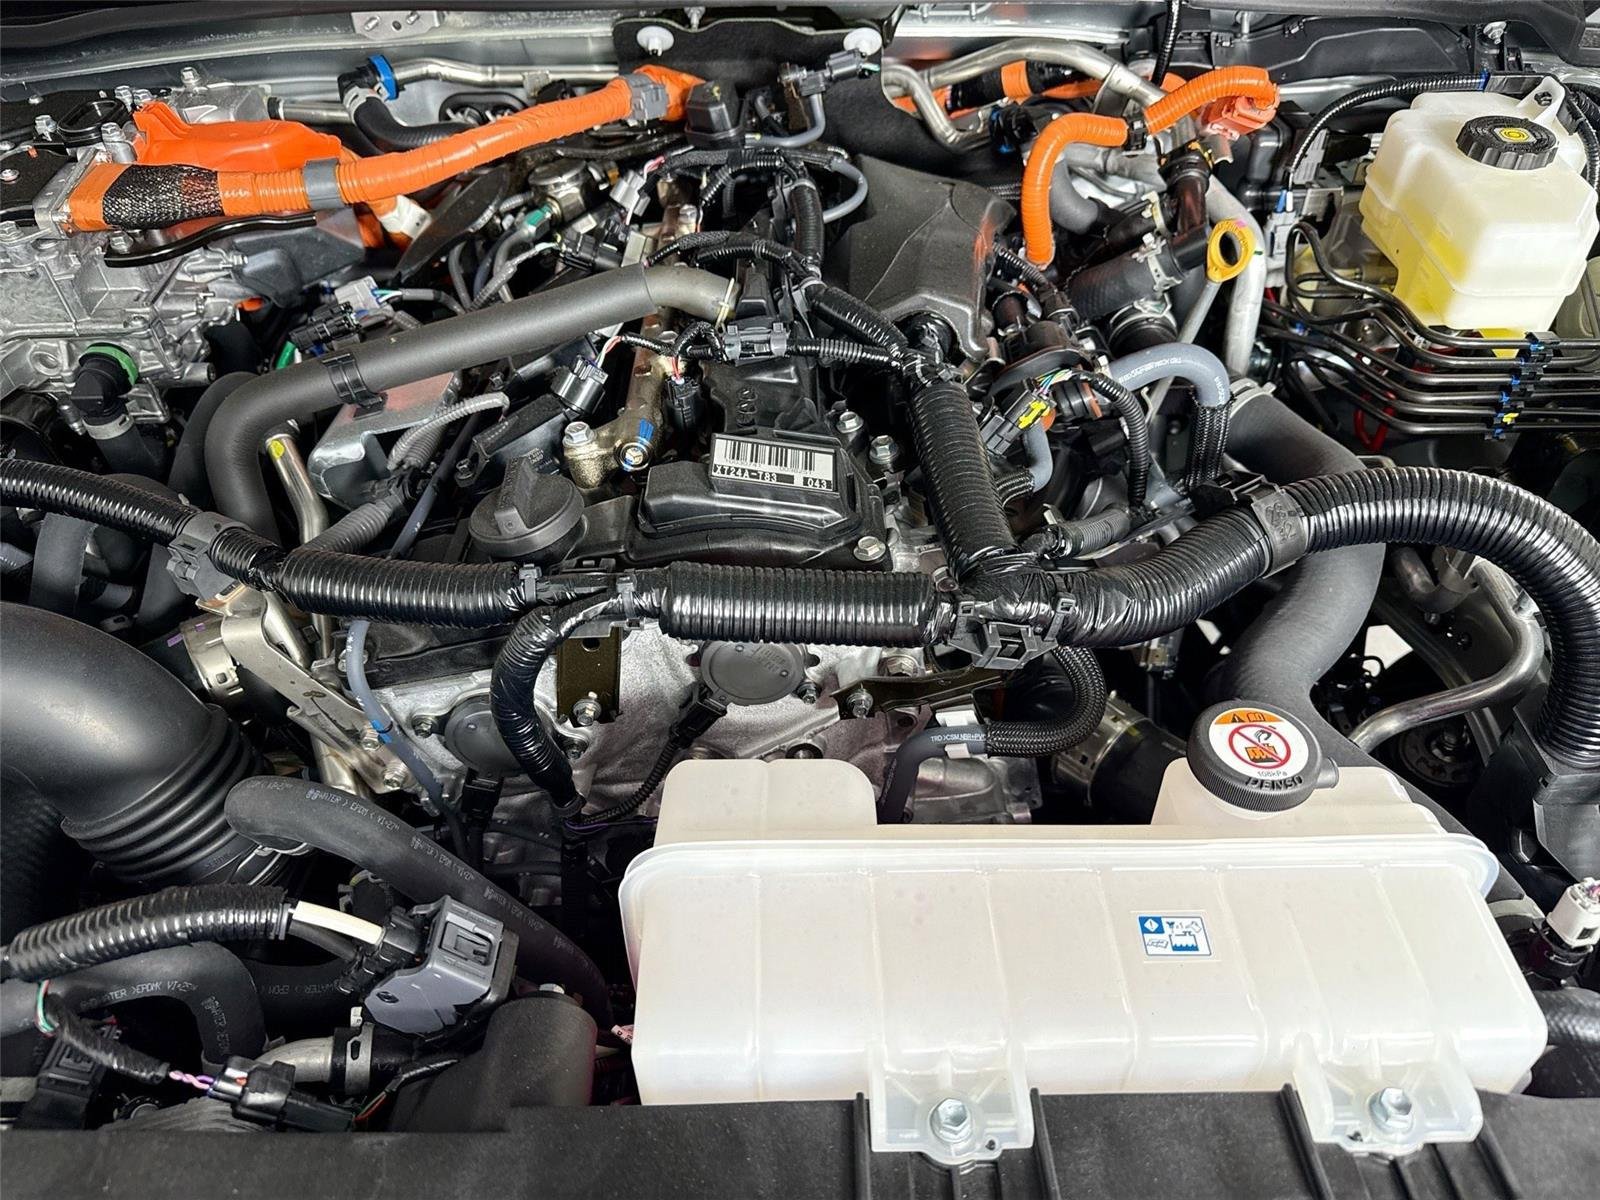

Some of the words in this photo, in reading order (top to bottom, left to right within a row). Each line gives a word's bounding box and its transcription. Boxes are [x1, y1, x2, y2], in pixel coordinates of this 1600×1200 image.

[714, 464, 778, 483] XT24A-T83
[807, 477, 827, 489] 043
[1245, 775, 1303, 791] DENSO
